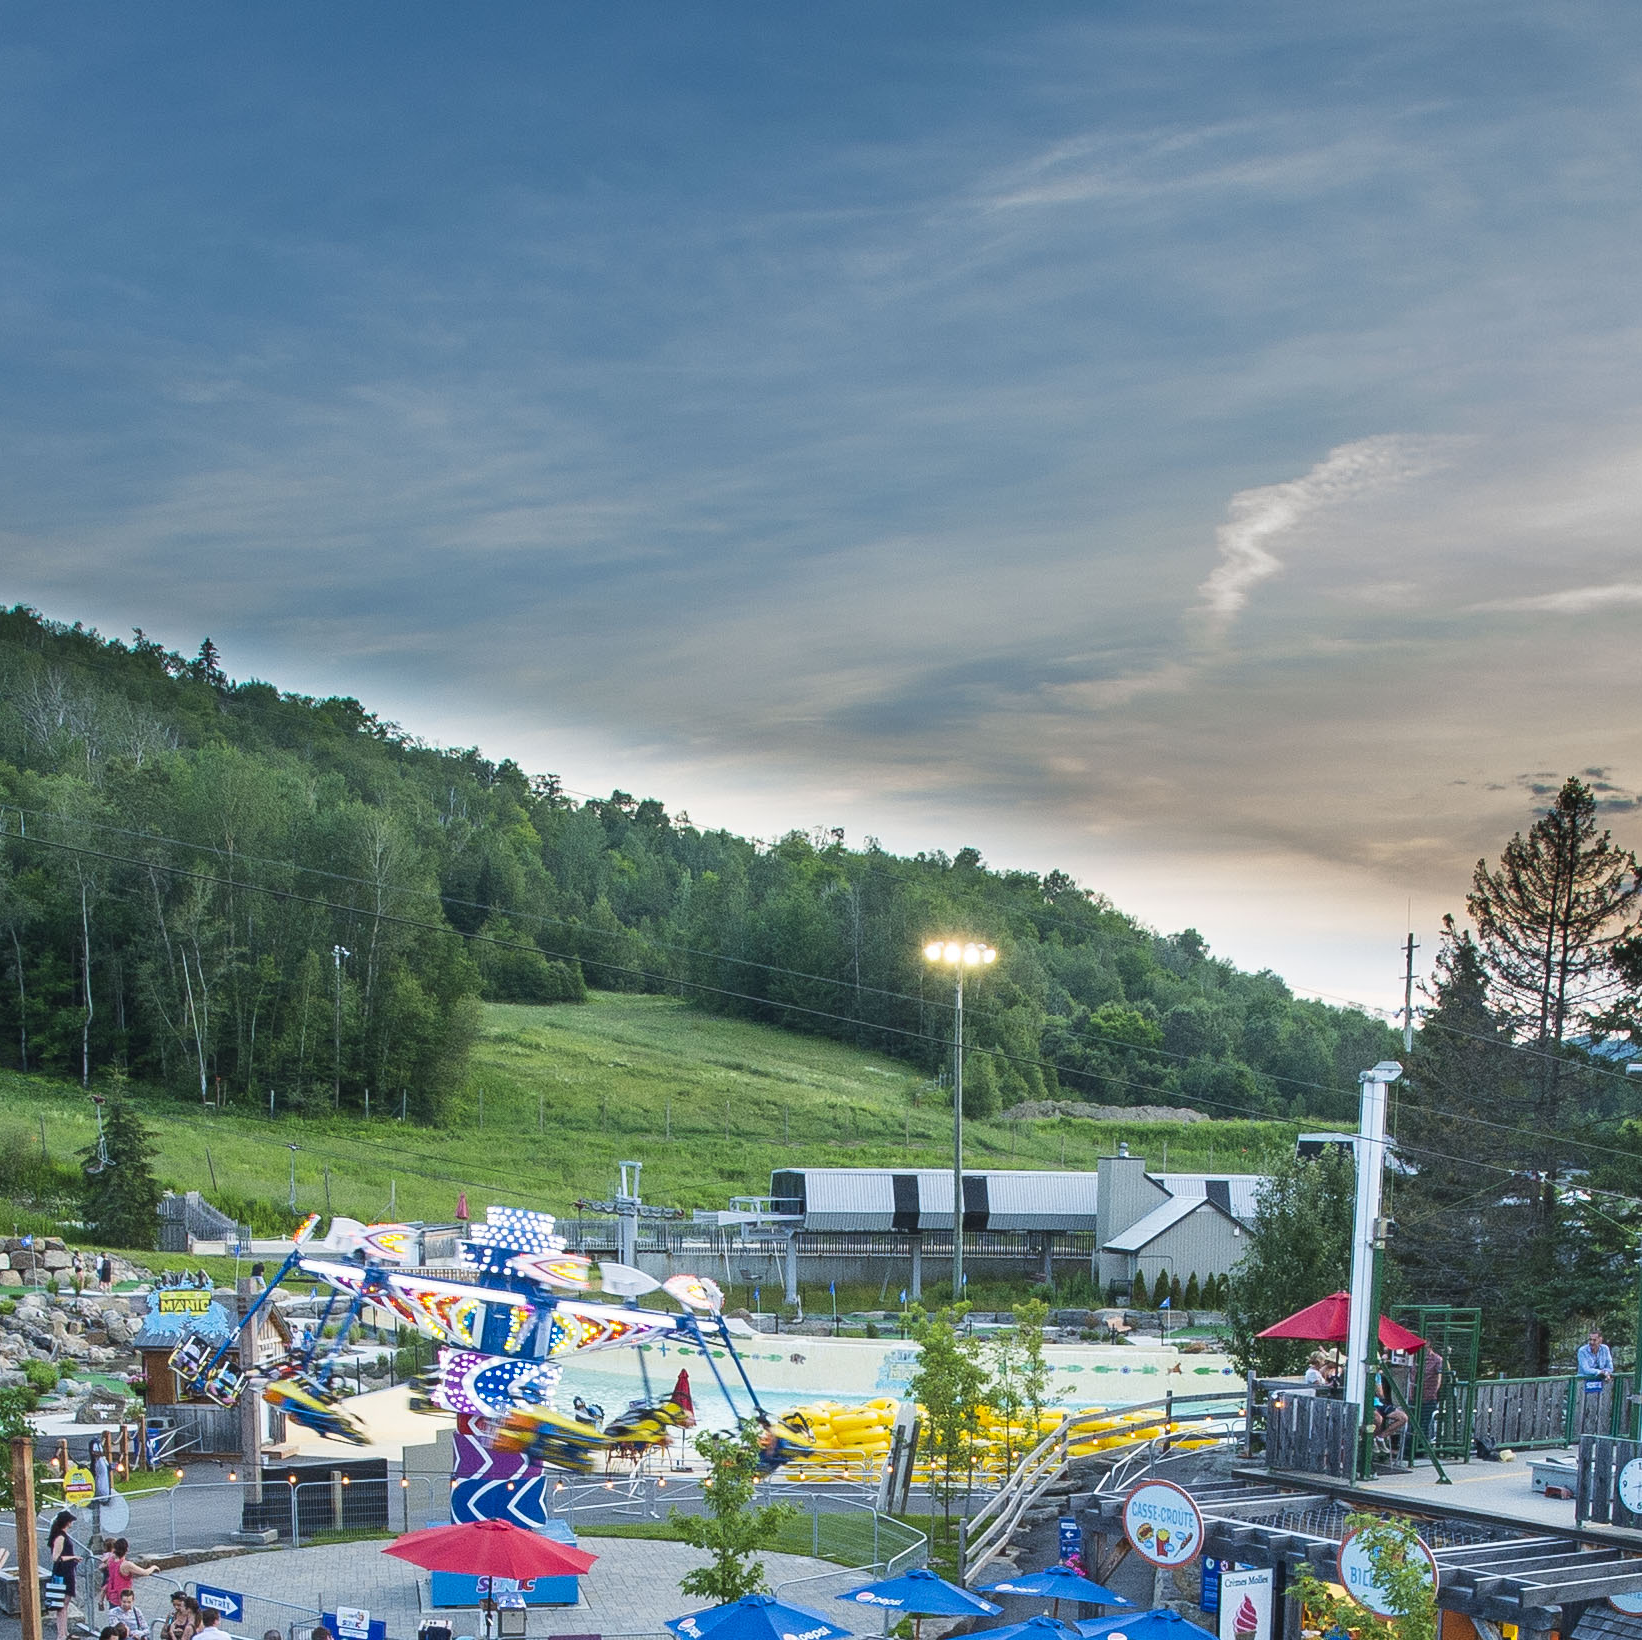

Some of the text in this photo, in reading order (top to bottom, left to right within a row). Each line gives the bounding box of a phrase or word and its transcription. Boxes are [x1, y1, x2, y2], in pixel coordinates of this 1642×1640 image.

[160, 1299, 210, 1312] MANIC
[1622, 1479, 1628, 1489] 9
[1636, 1501, 1642, 1510] 6
[1131, 1500, 1195, 1529] CASSE-CROÛTE
[476, 1574, 538, 1592] SONIC
[1224, 1574, 1269, 1588] Crèmes Molles
[870, 1595, 905, 1607] pepsi
